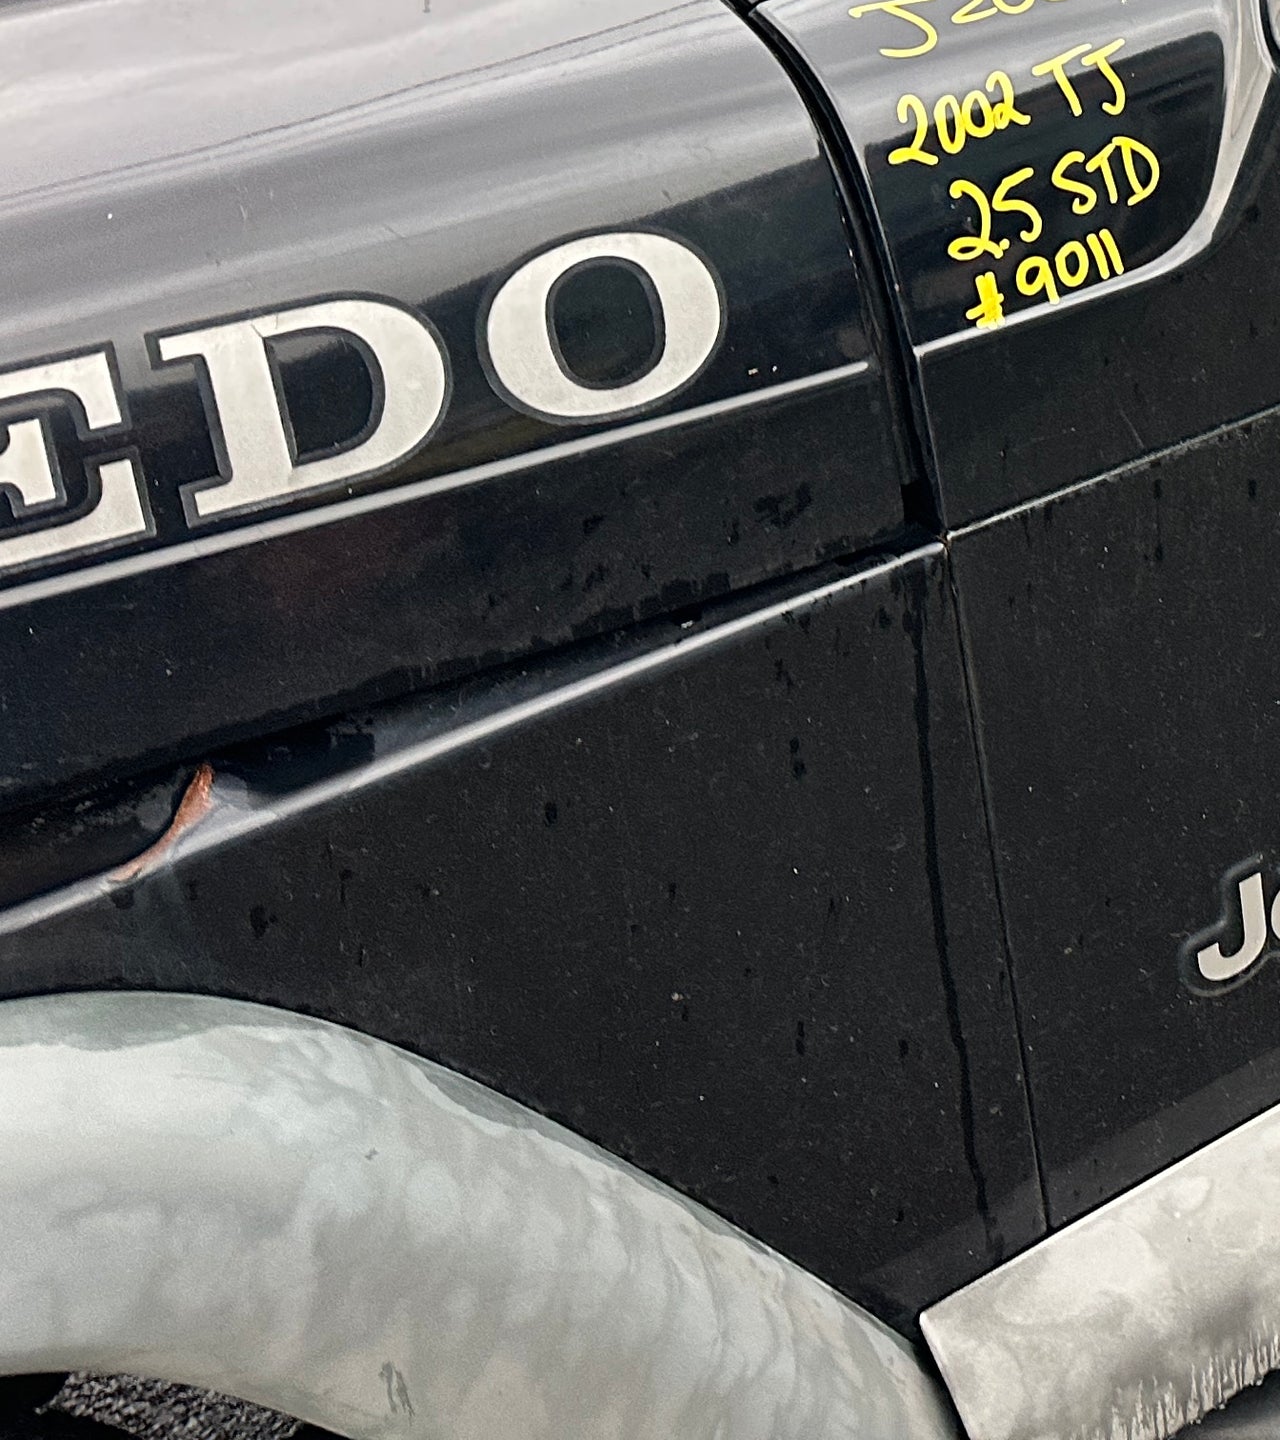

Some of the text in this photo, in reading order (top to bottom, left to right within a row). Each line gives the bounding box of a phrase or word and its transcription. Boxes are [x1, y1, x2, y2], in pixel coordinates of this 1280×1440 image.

[887, 37, 1126, 166] 2002 TJ
[1051, 136, 1160, 215] STD
[964, 227, 1125, 329] #9011
